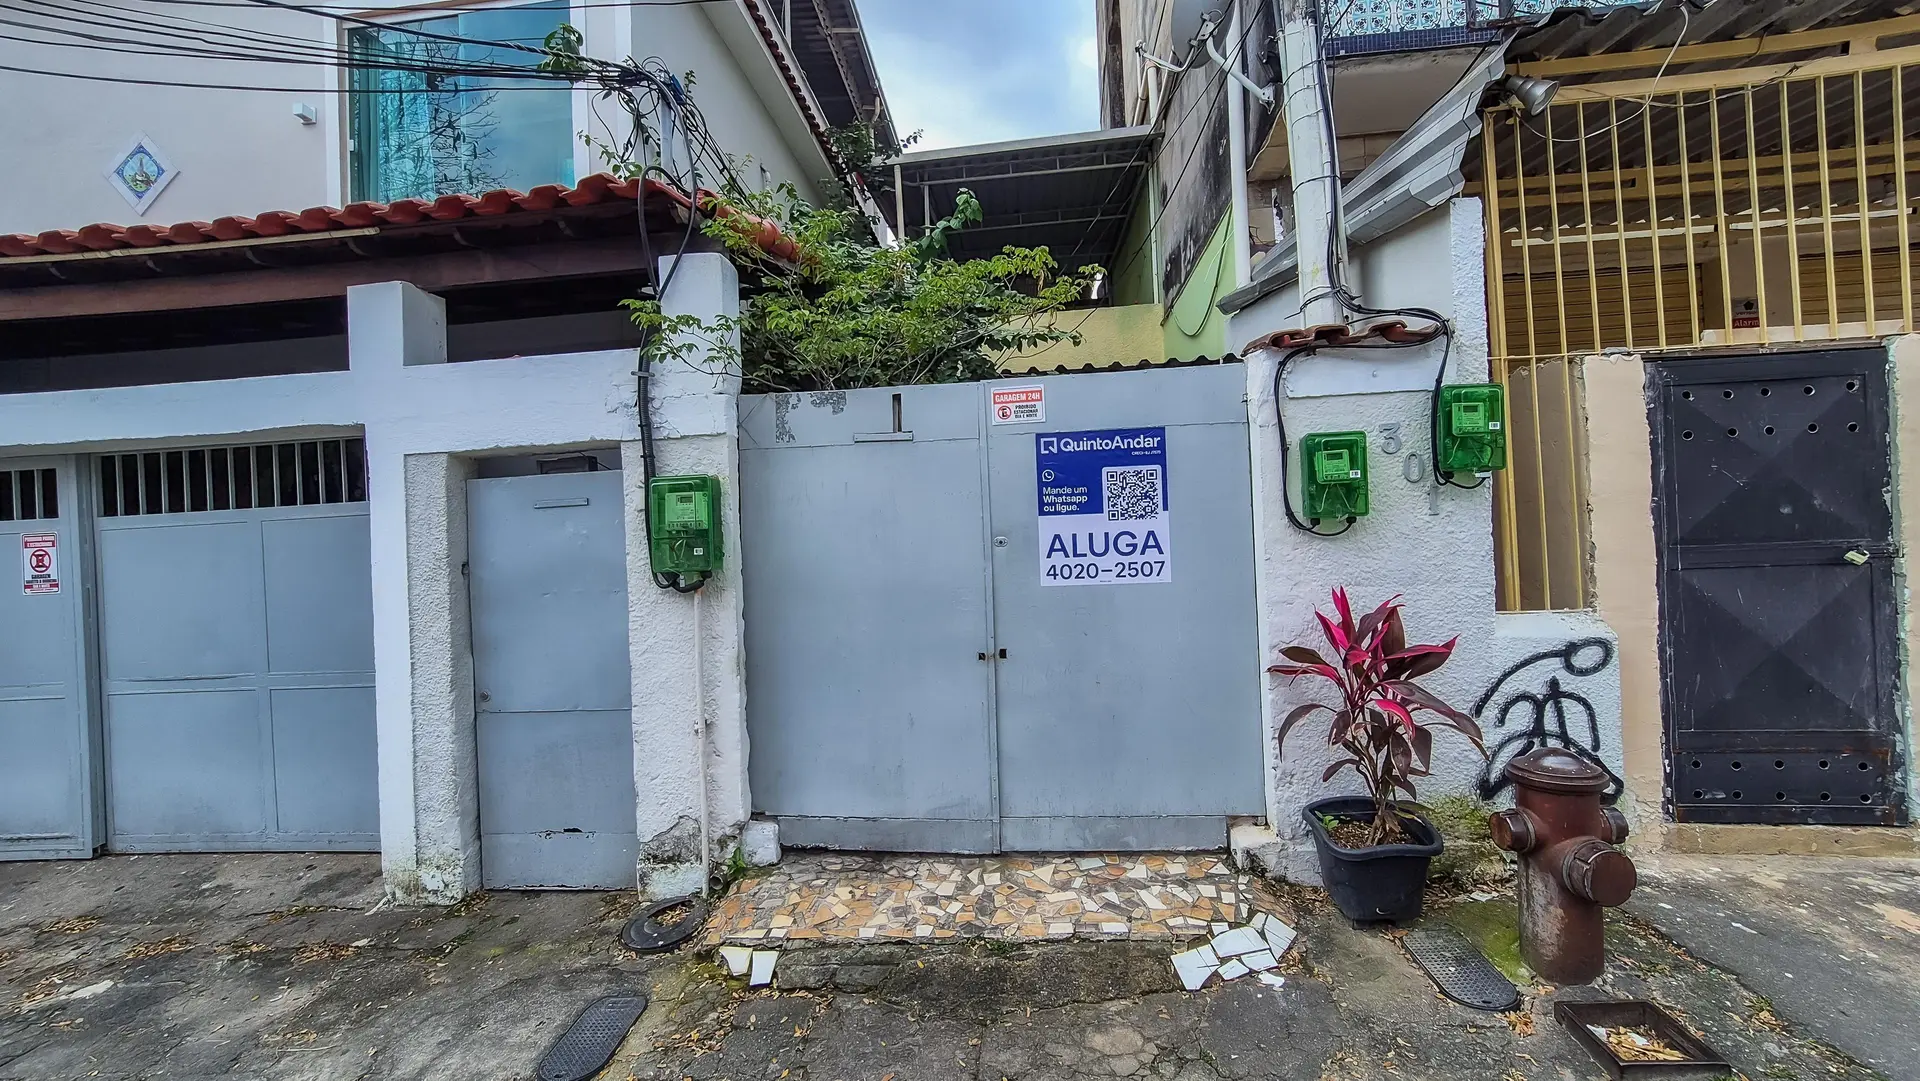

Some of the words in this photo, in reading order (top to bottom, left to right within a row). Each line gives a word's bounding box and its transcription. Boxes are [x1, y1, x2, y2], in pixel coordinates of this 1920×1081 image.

[995, 393, 1026, 402] GARAGEM
[1028, 392, 1040, 400] 24H
[1060, 435, 1160, 452] QuintoAndar
[1043, 486, 1072, 494] Mande
[1043, 495, 1088, 504] Whatsapp
[1056, 503, 1080, 513] ligue.
[1046, 530, 1164, 558] ALUGA
[1046, 561, 1165, 580] 4020-2507
